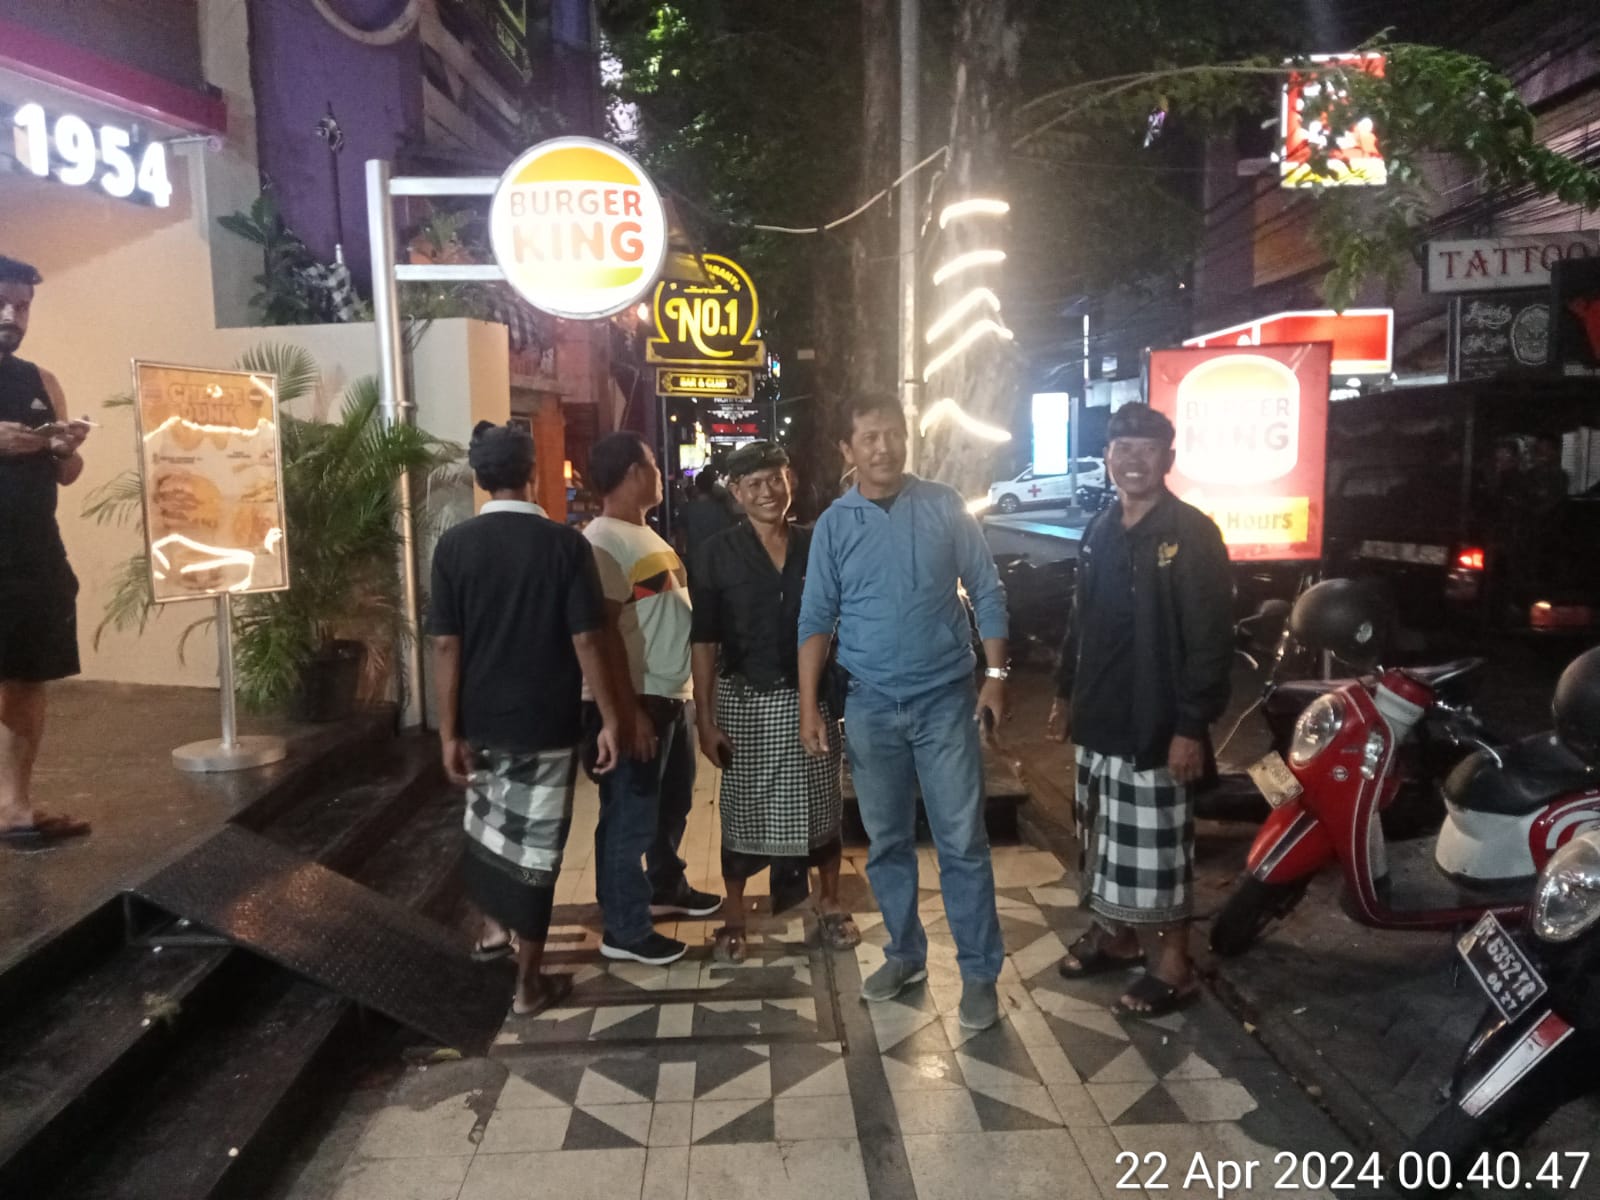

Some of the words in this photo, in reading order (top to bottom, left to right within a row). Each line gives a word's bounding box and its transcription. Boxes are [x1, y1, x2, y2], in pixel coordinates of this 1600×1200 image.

[14, 103, 173, 207] 1954
[510, 189, 643, 217] BURGER
[512, 221, 645, 264] KING
[665, 297, 739, 357] NO.1
[1227, 513, 1294, 530] Hours
[1487, 937, 1522, 980] 6352
